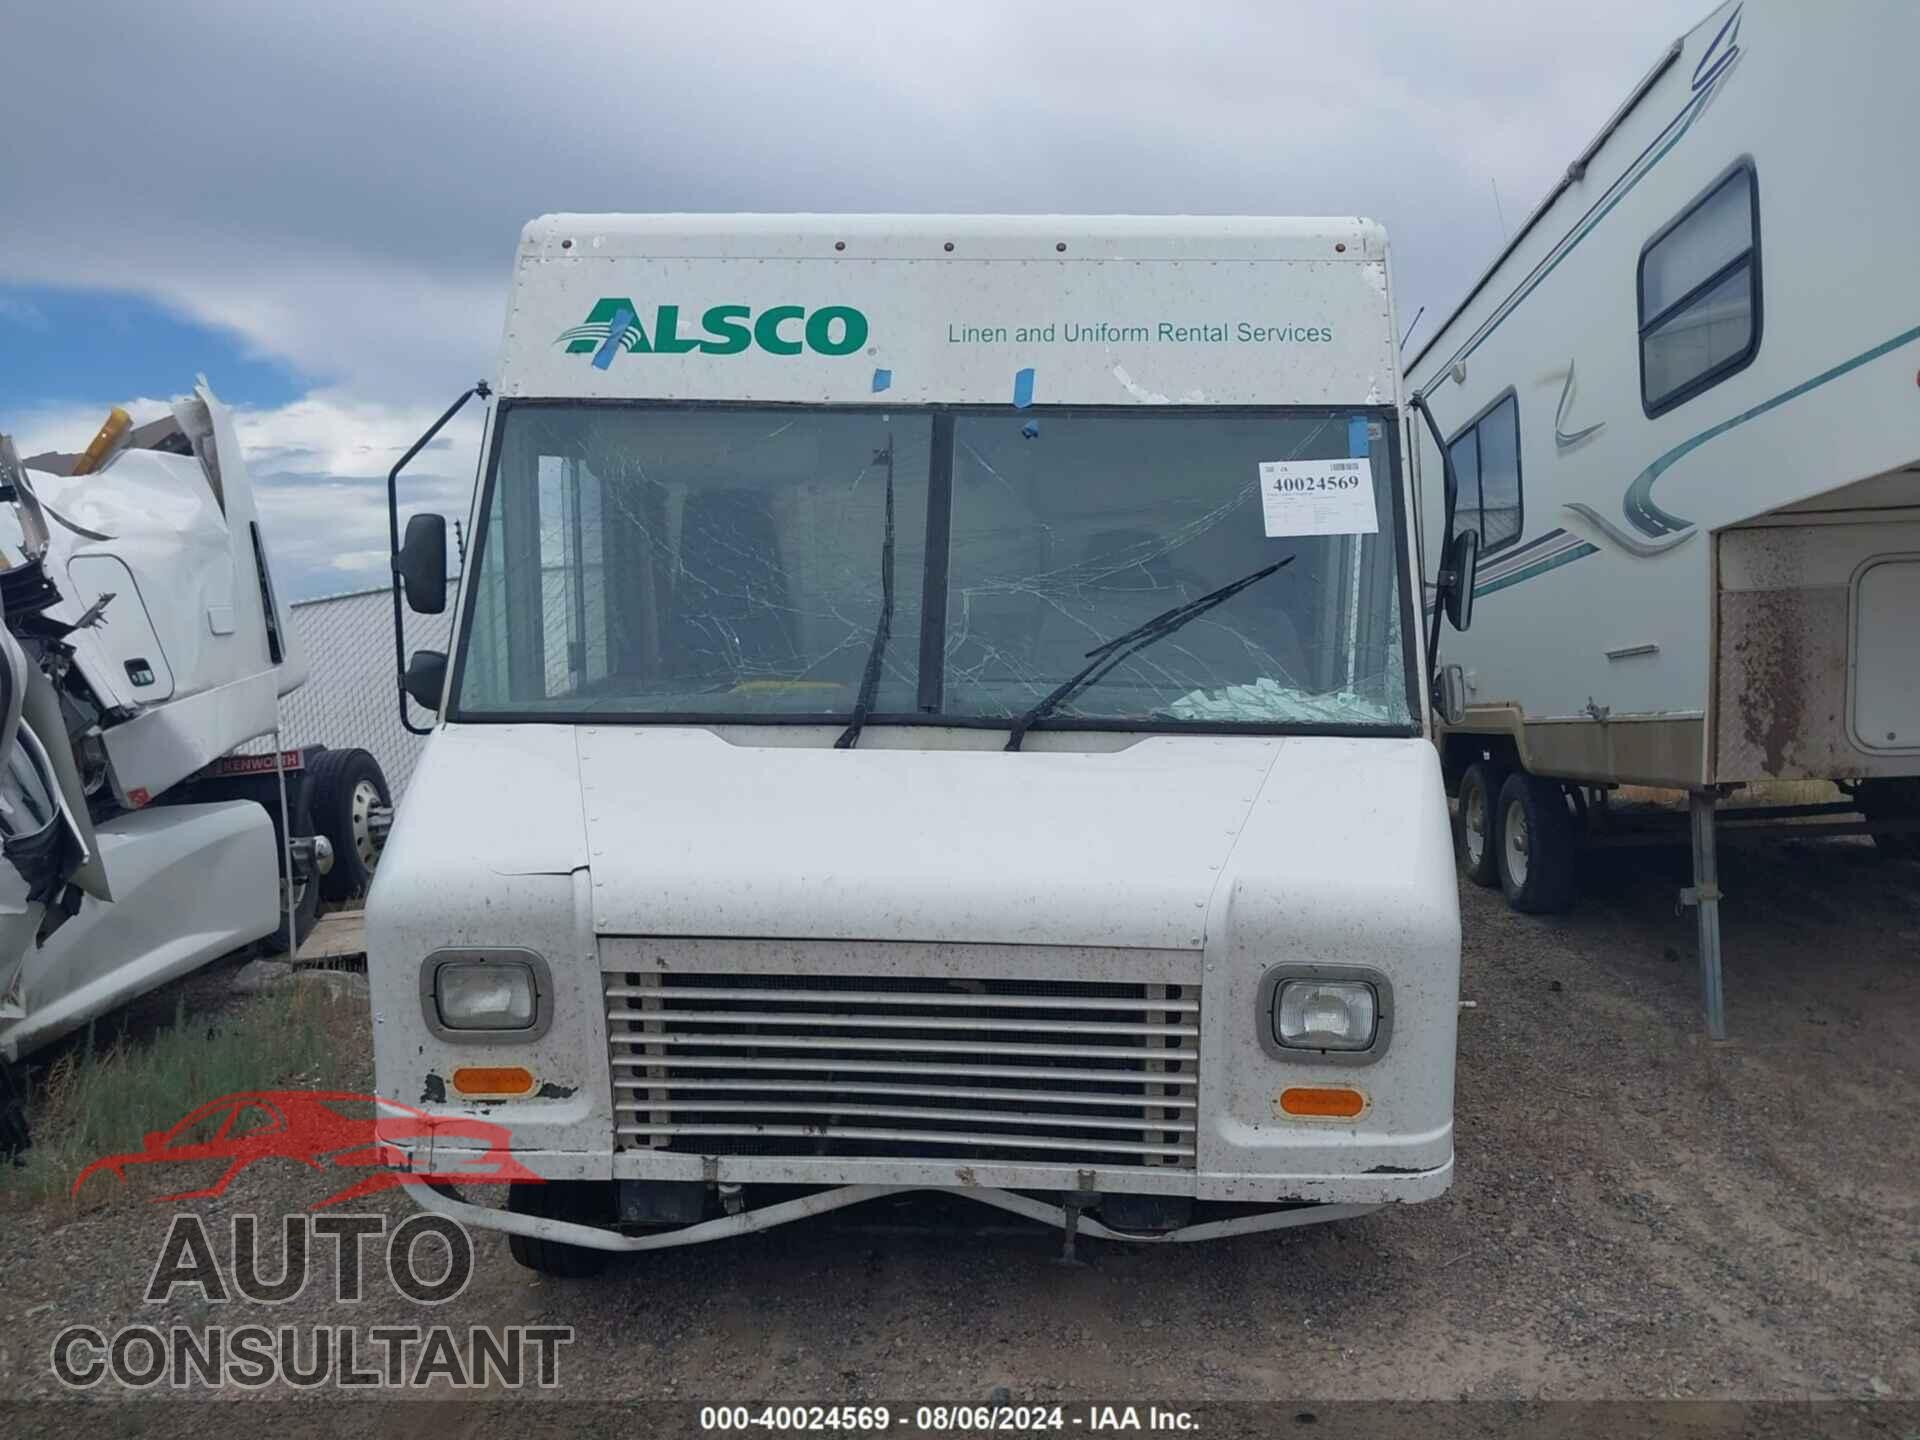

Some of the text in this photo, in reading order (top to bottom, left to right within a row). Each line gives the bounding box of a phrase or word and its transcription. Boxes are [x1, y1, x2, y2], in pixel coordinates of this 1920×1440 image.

[554, 297, 869, 356] ALSCO
[948, 322, 1333, 343] Linen and Uniform Rental Services
[1272, 475, 1360, 492] 40024569
